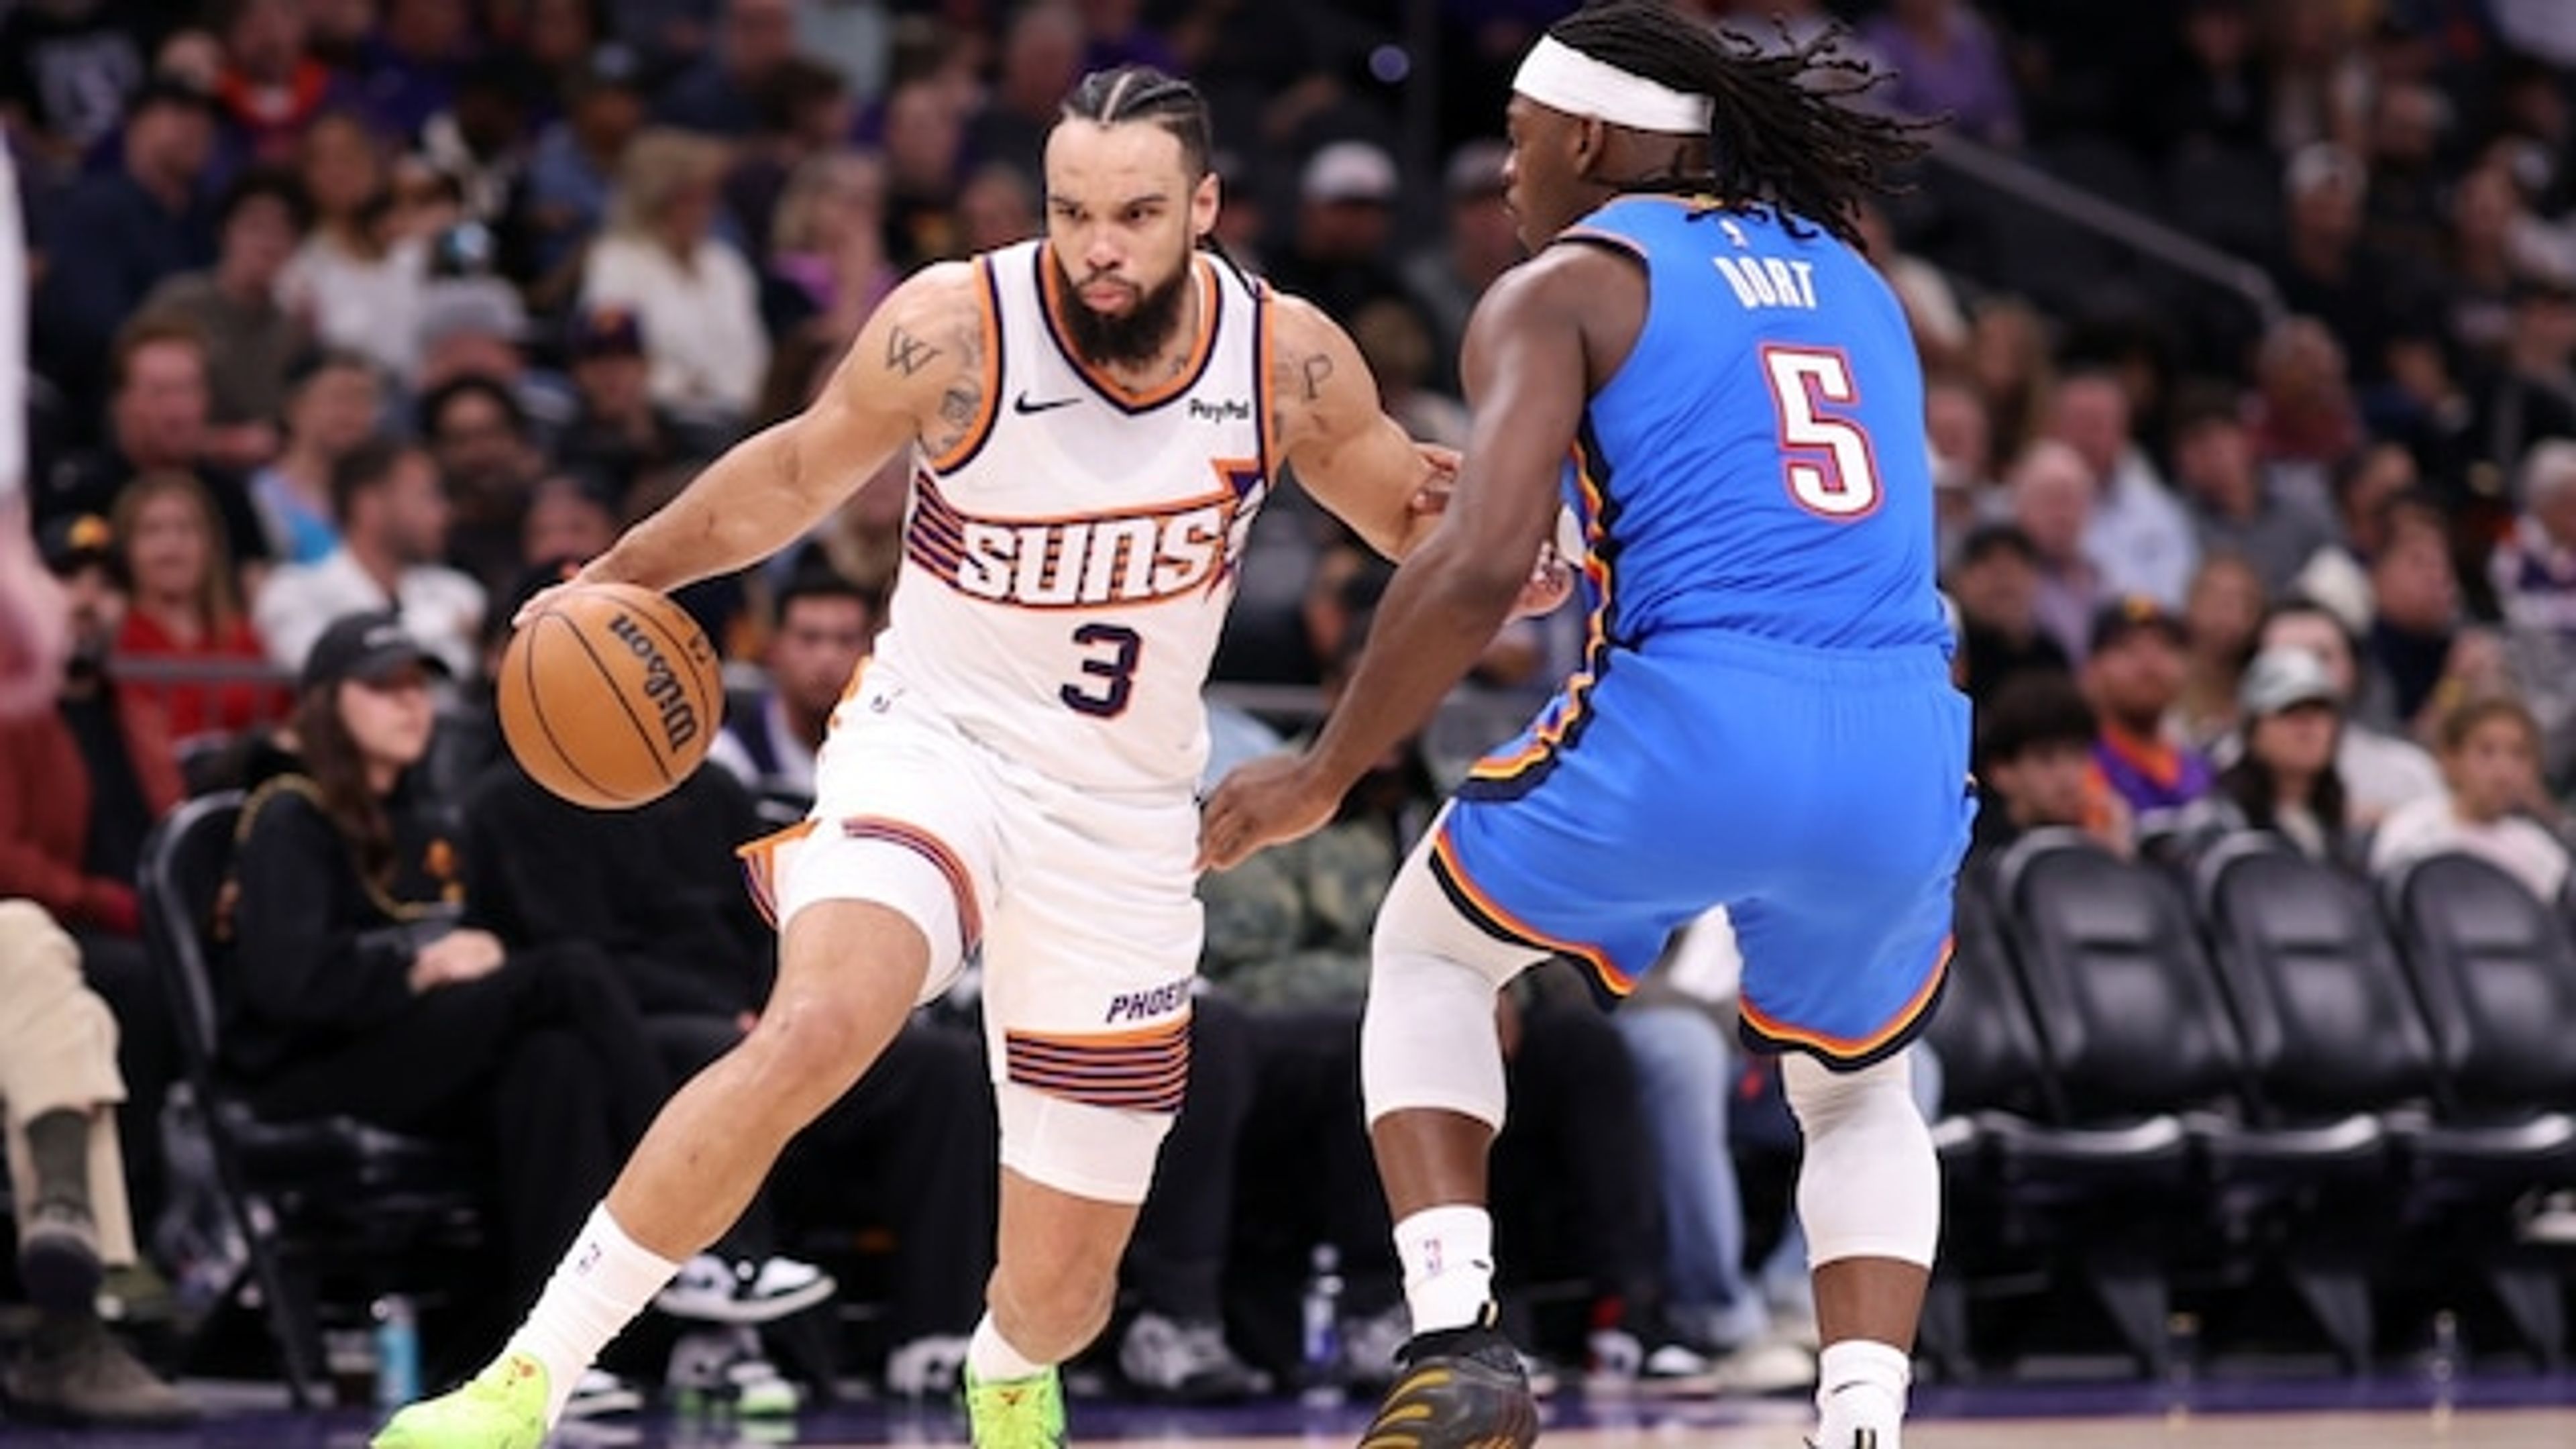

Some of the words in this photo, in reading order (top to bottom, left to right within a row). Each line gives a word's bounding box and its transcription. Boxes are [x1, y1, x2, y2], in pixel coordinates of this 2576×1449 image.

[1713, 257, 1817, 309] DORT
[1190, 398, 1249, 424] PayPal
[1758, 340, 1884, 524] 5
[608, 612, 698, 753] Wilson
[1060, 623, 1142, 718] 3
